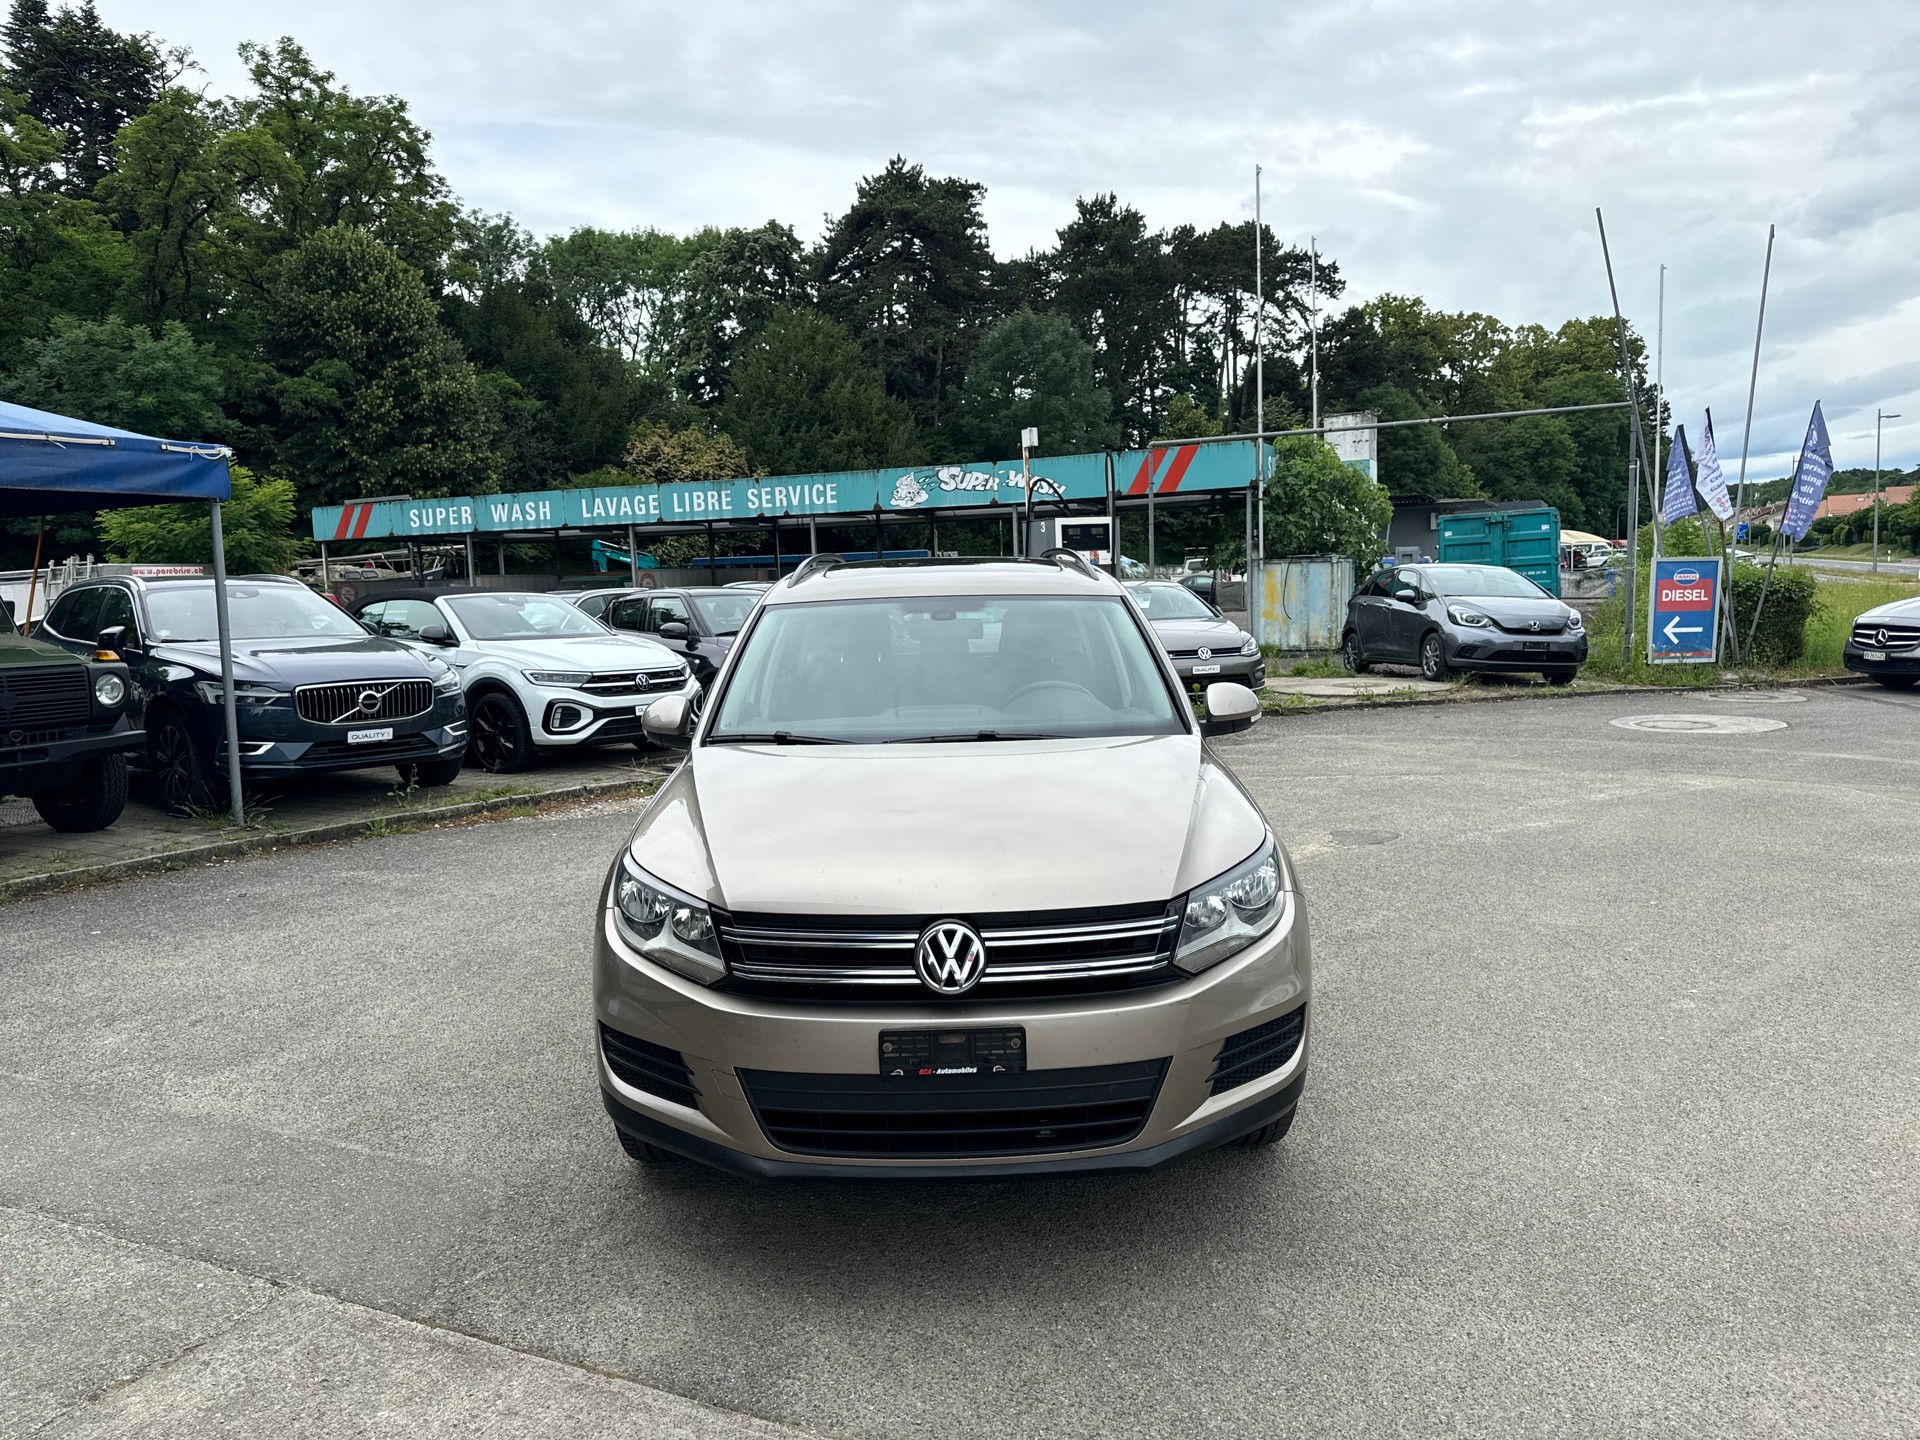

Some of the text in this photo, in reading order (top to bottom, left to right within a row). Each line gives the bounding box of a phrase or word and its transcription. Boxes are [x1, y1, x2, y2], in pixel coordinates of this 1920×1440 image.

[938, 466, 1000, 492] SUPER
[409, 483, 838, 528] SUPER WASH LAVAGE LIBRE SERVICE
[1040, 521, 1046, 533] 3
[1661, 589, 1709, 602] DIESEL
[351, 732, 386, 740] QUALITY
[936, 1066, 977, 1075] Automobiles
